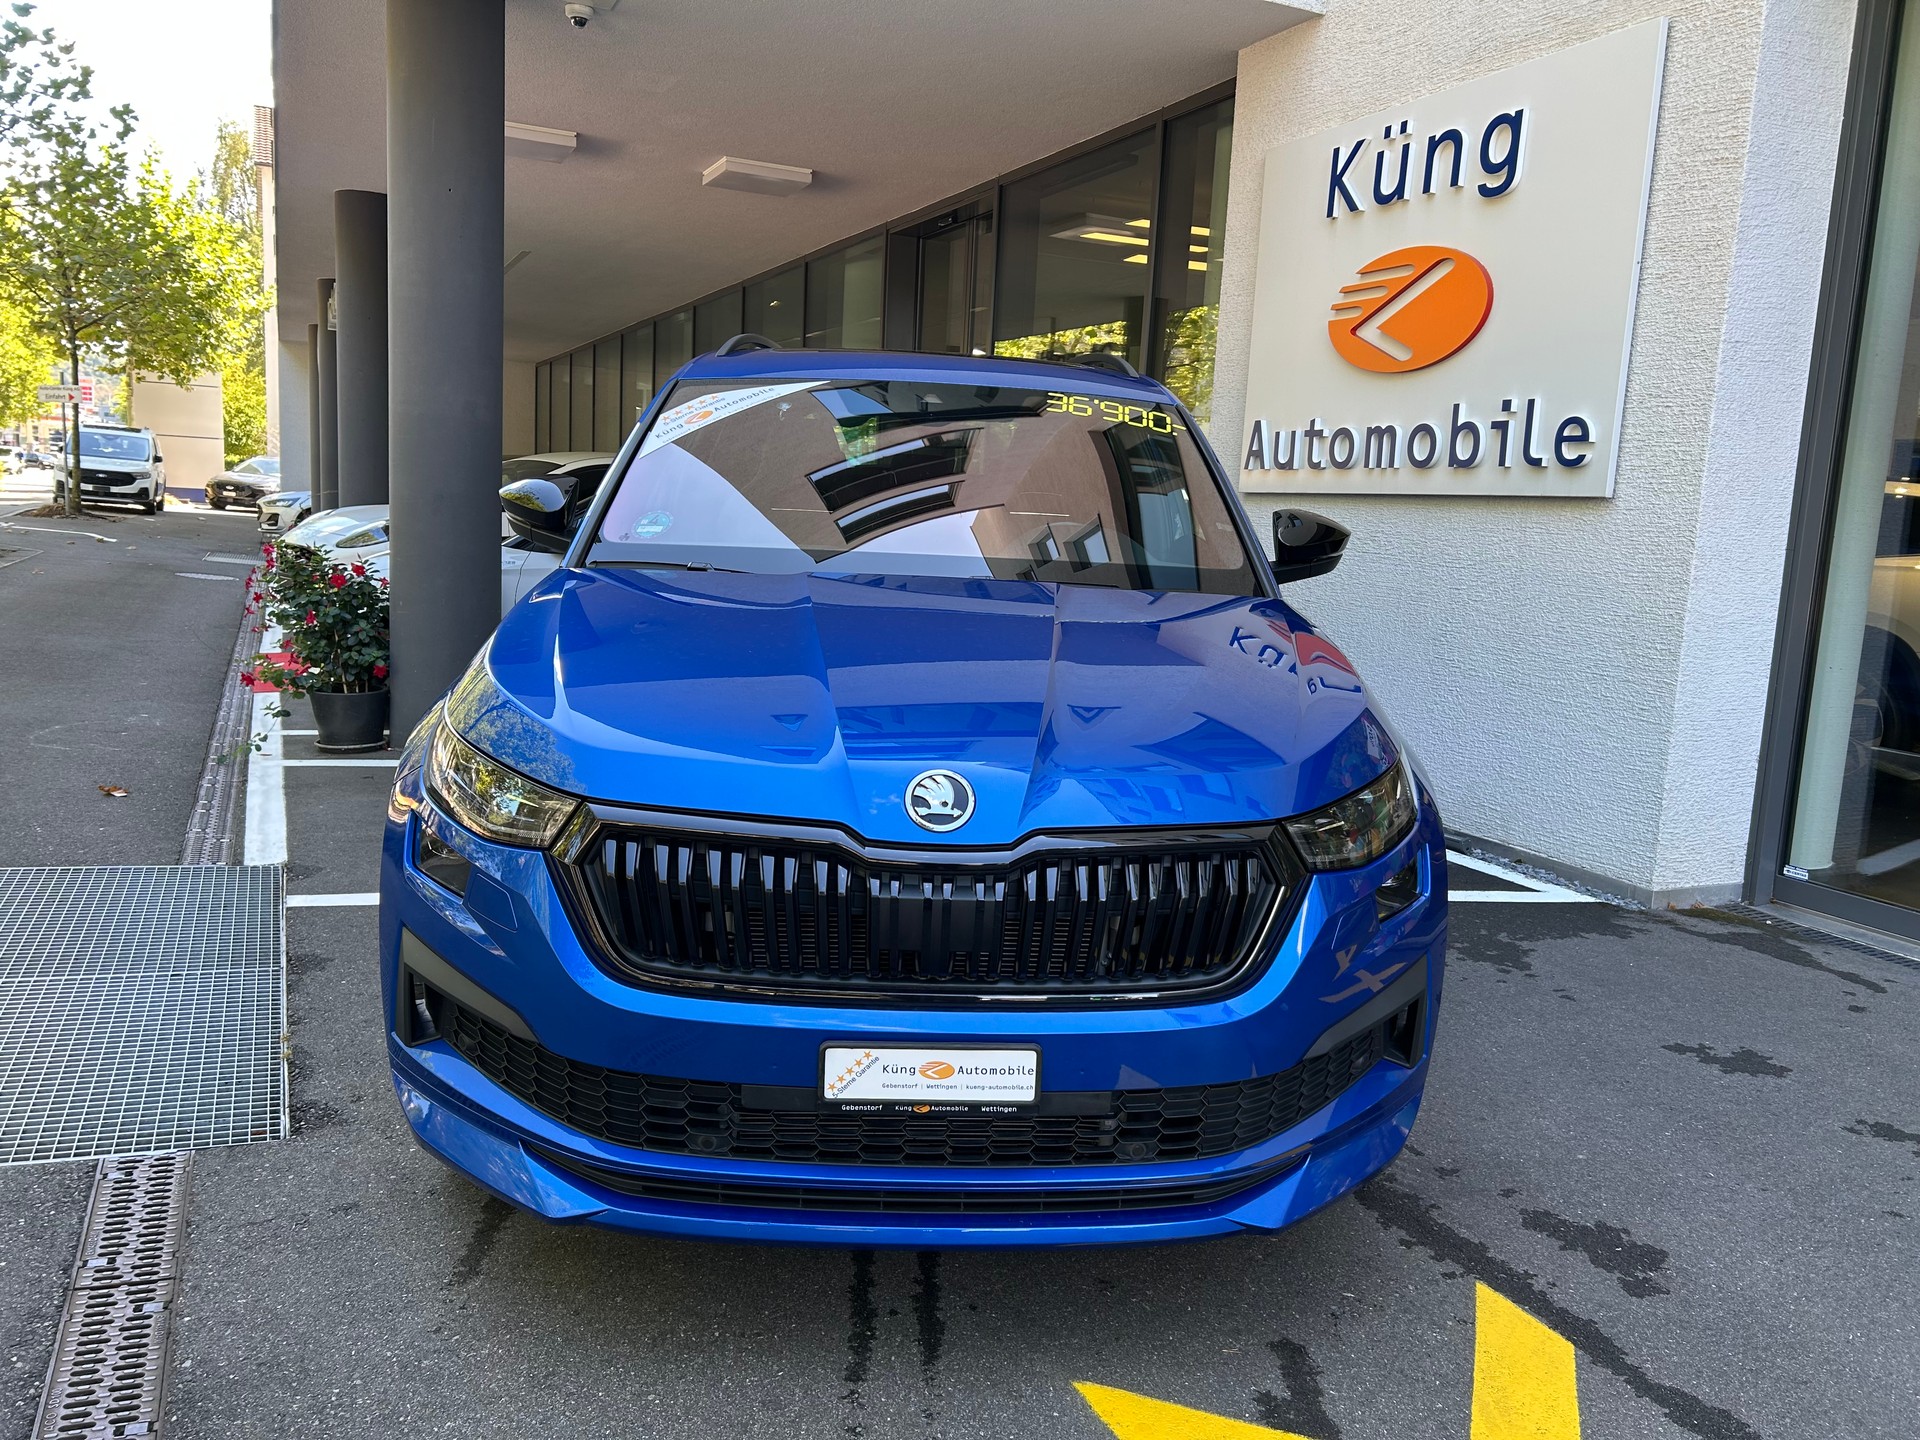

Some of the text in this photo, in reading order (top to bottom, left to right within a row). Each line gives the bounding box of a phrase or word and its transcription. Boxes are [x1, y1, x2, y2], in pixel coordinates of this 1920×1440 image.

[1326, 108, 1529, 219] Küng
[655, 423, 684, 439] Küng
[714, 387, 775, 412] Automobile
[1244, 398, 1596, 470] Automobile
[832, 1056, 880, 1099] 5-Sterne Garantie
[882, 1064, 1035, 1076] Küng Automobile
[981, 1105, 1018, 1113] Wettingen
[43, 1413, 58, 1431] ACO
